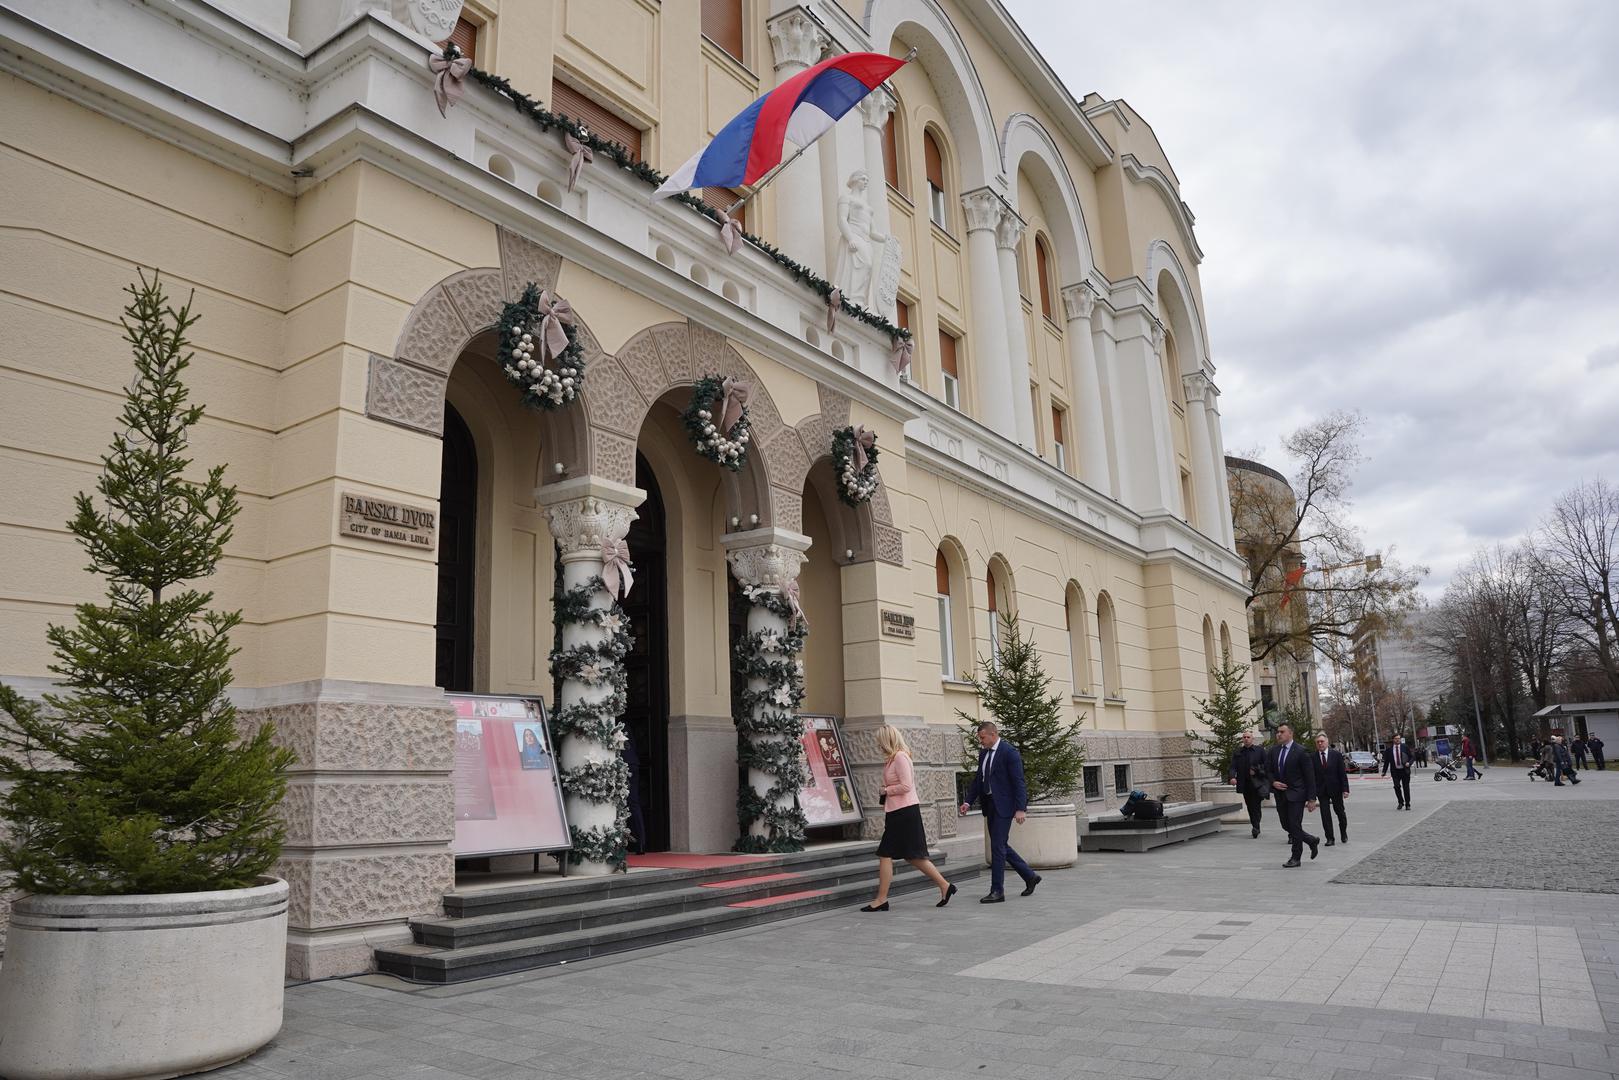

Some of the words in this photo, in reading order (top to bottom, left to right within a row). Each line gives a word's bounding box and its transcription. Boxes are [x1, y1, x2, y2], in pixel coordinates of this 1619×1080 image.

[345, 496, 399, 522] BANSKI
[402, 508, 435, 529] DVOR
[350, 523, 368, 534] CITY
[371, 527, 381, 536] OF
[384, 529, 407, 541] BANJA
[410, 534, 429, 545] LUKA
